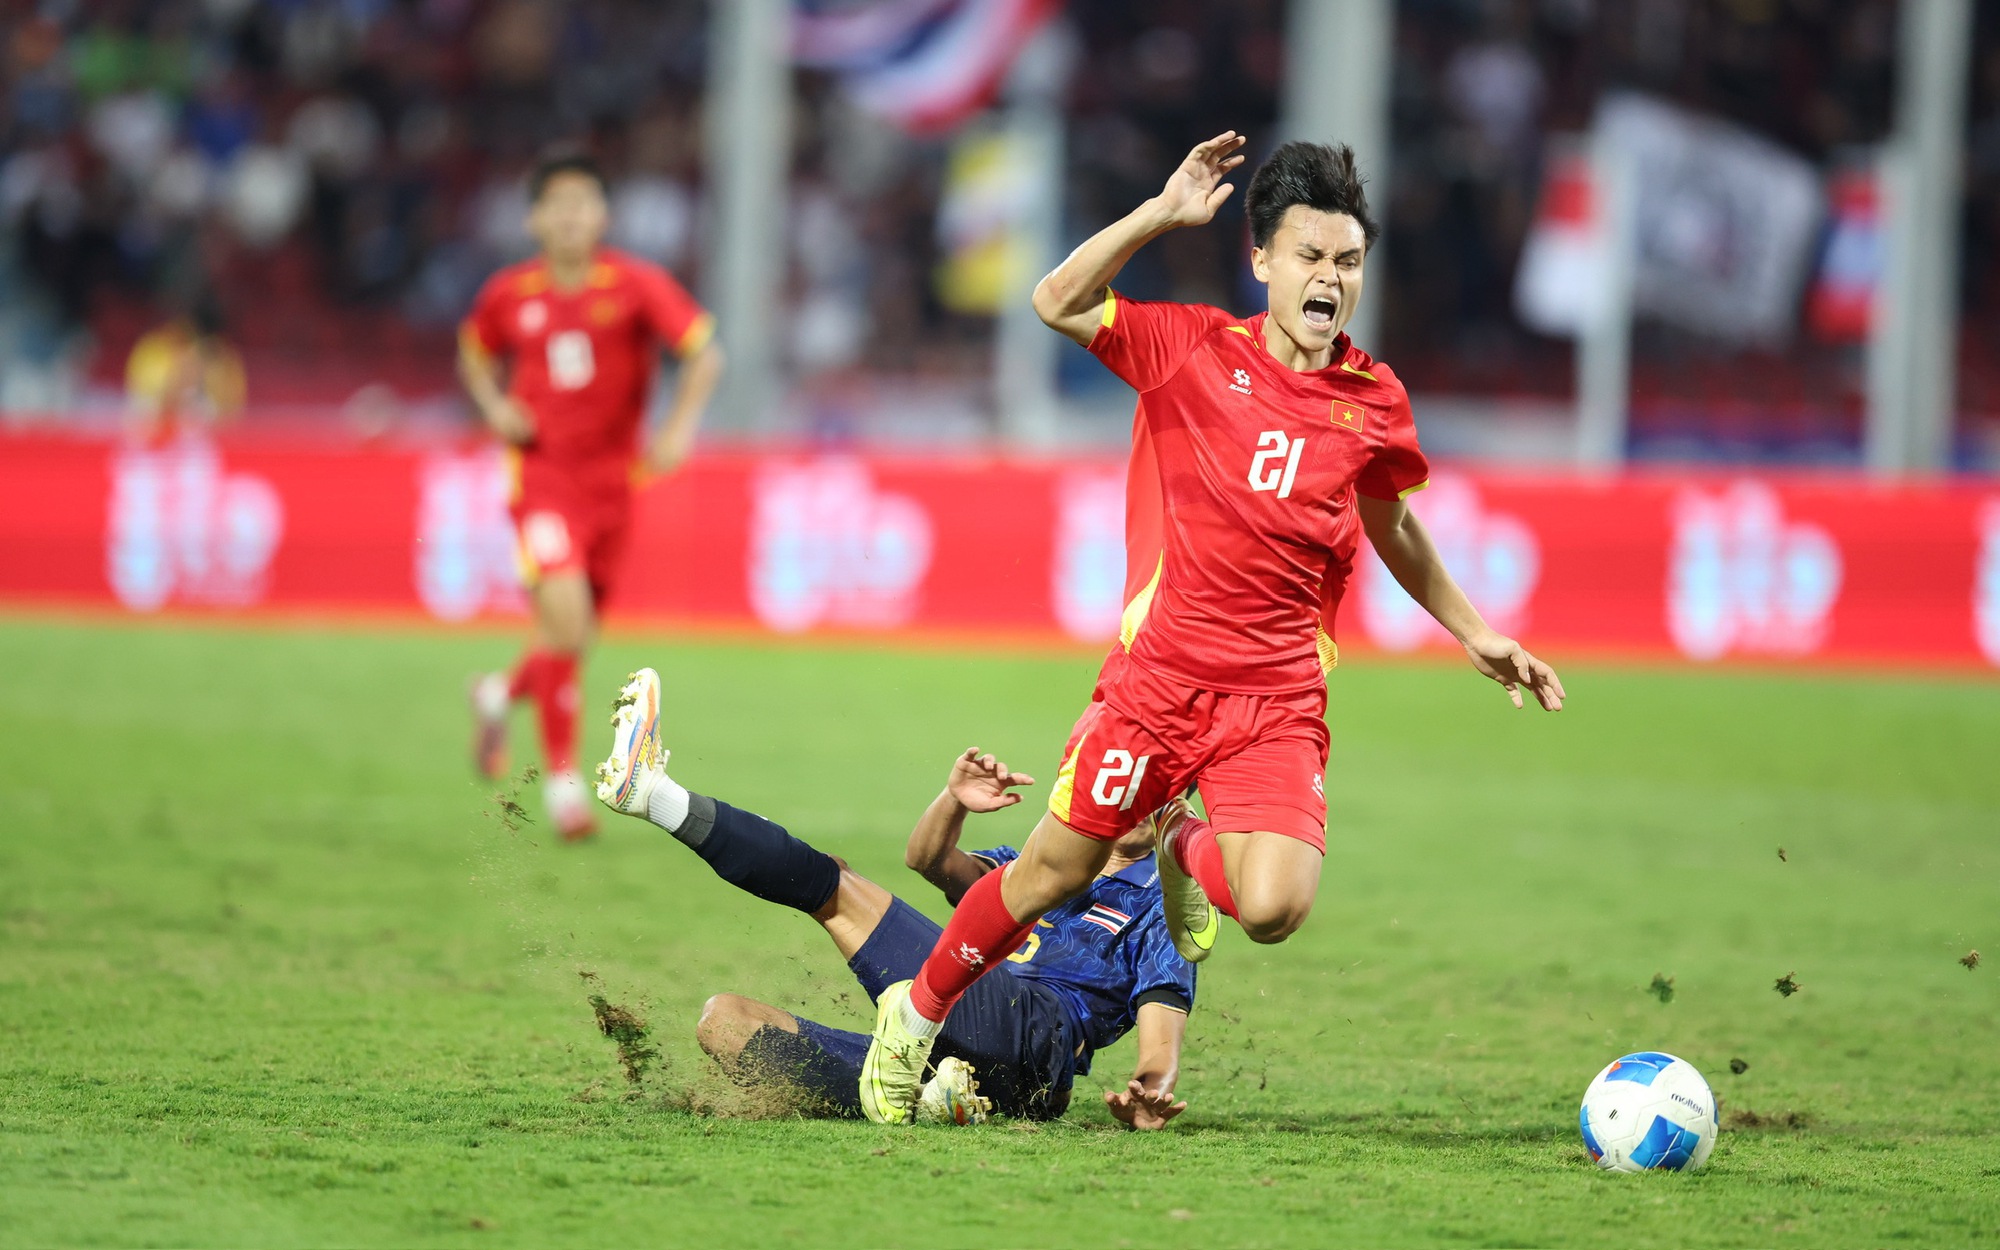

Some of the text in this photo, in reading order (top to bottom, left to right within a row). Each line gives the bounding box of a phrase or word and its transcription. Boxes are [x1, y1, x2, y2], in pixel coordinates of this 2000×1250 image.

[1247, 430, 1306, 499] 21
[1091, 749, 1150, 812] 21
[1671, 1093, 1704, 1116] molten
